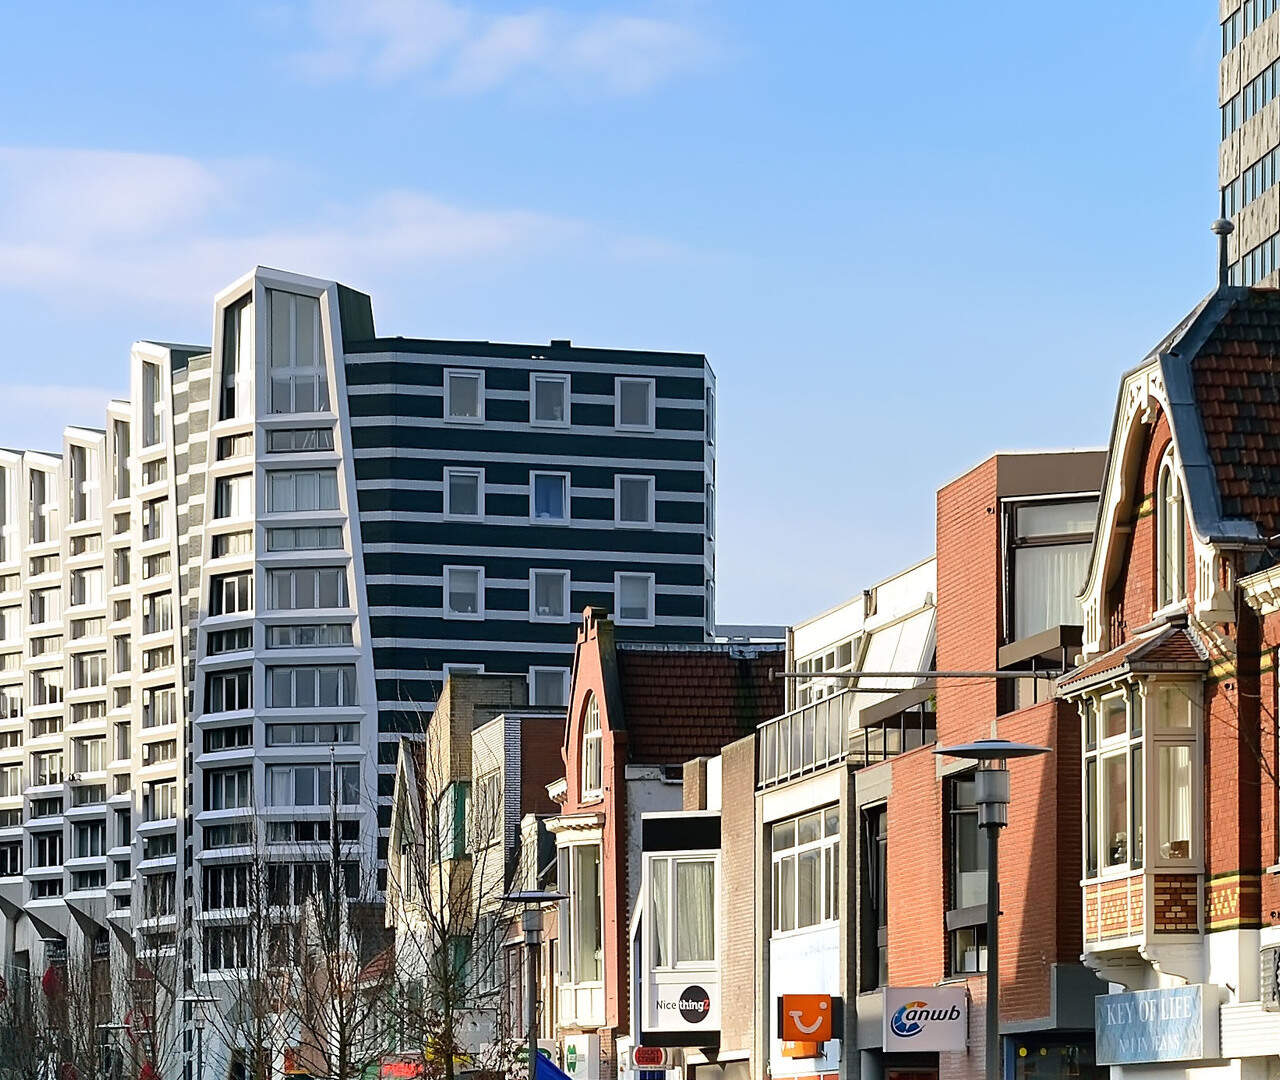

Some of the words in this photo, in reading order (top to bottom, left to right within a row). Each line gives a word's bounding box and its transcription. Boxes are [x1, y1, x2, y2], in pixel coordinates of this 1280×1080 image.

[656, 1000, 676, 1010] Nice
[905, 1005, 961, 1021] anwb
[1106, 1002, 1135, 1026] KEY
[1139, 999, 1156, 1022] OF
[1160, 996, 1192, 1020] LIFE
